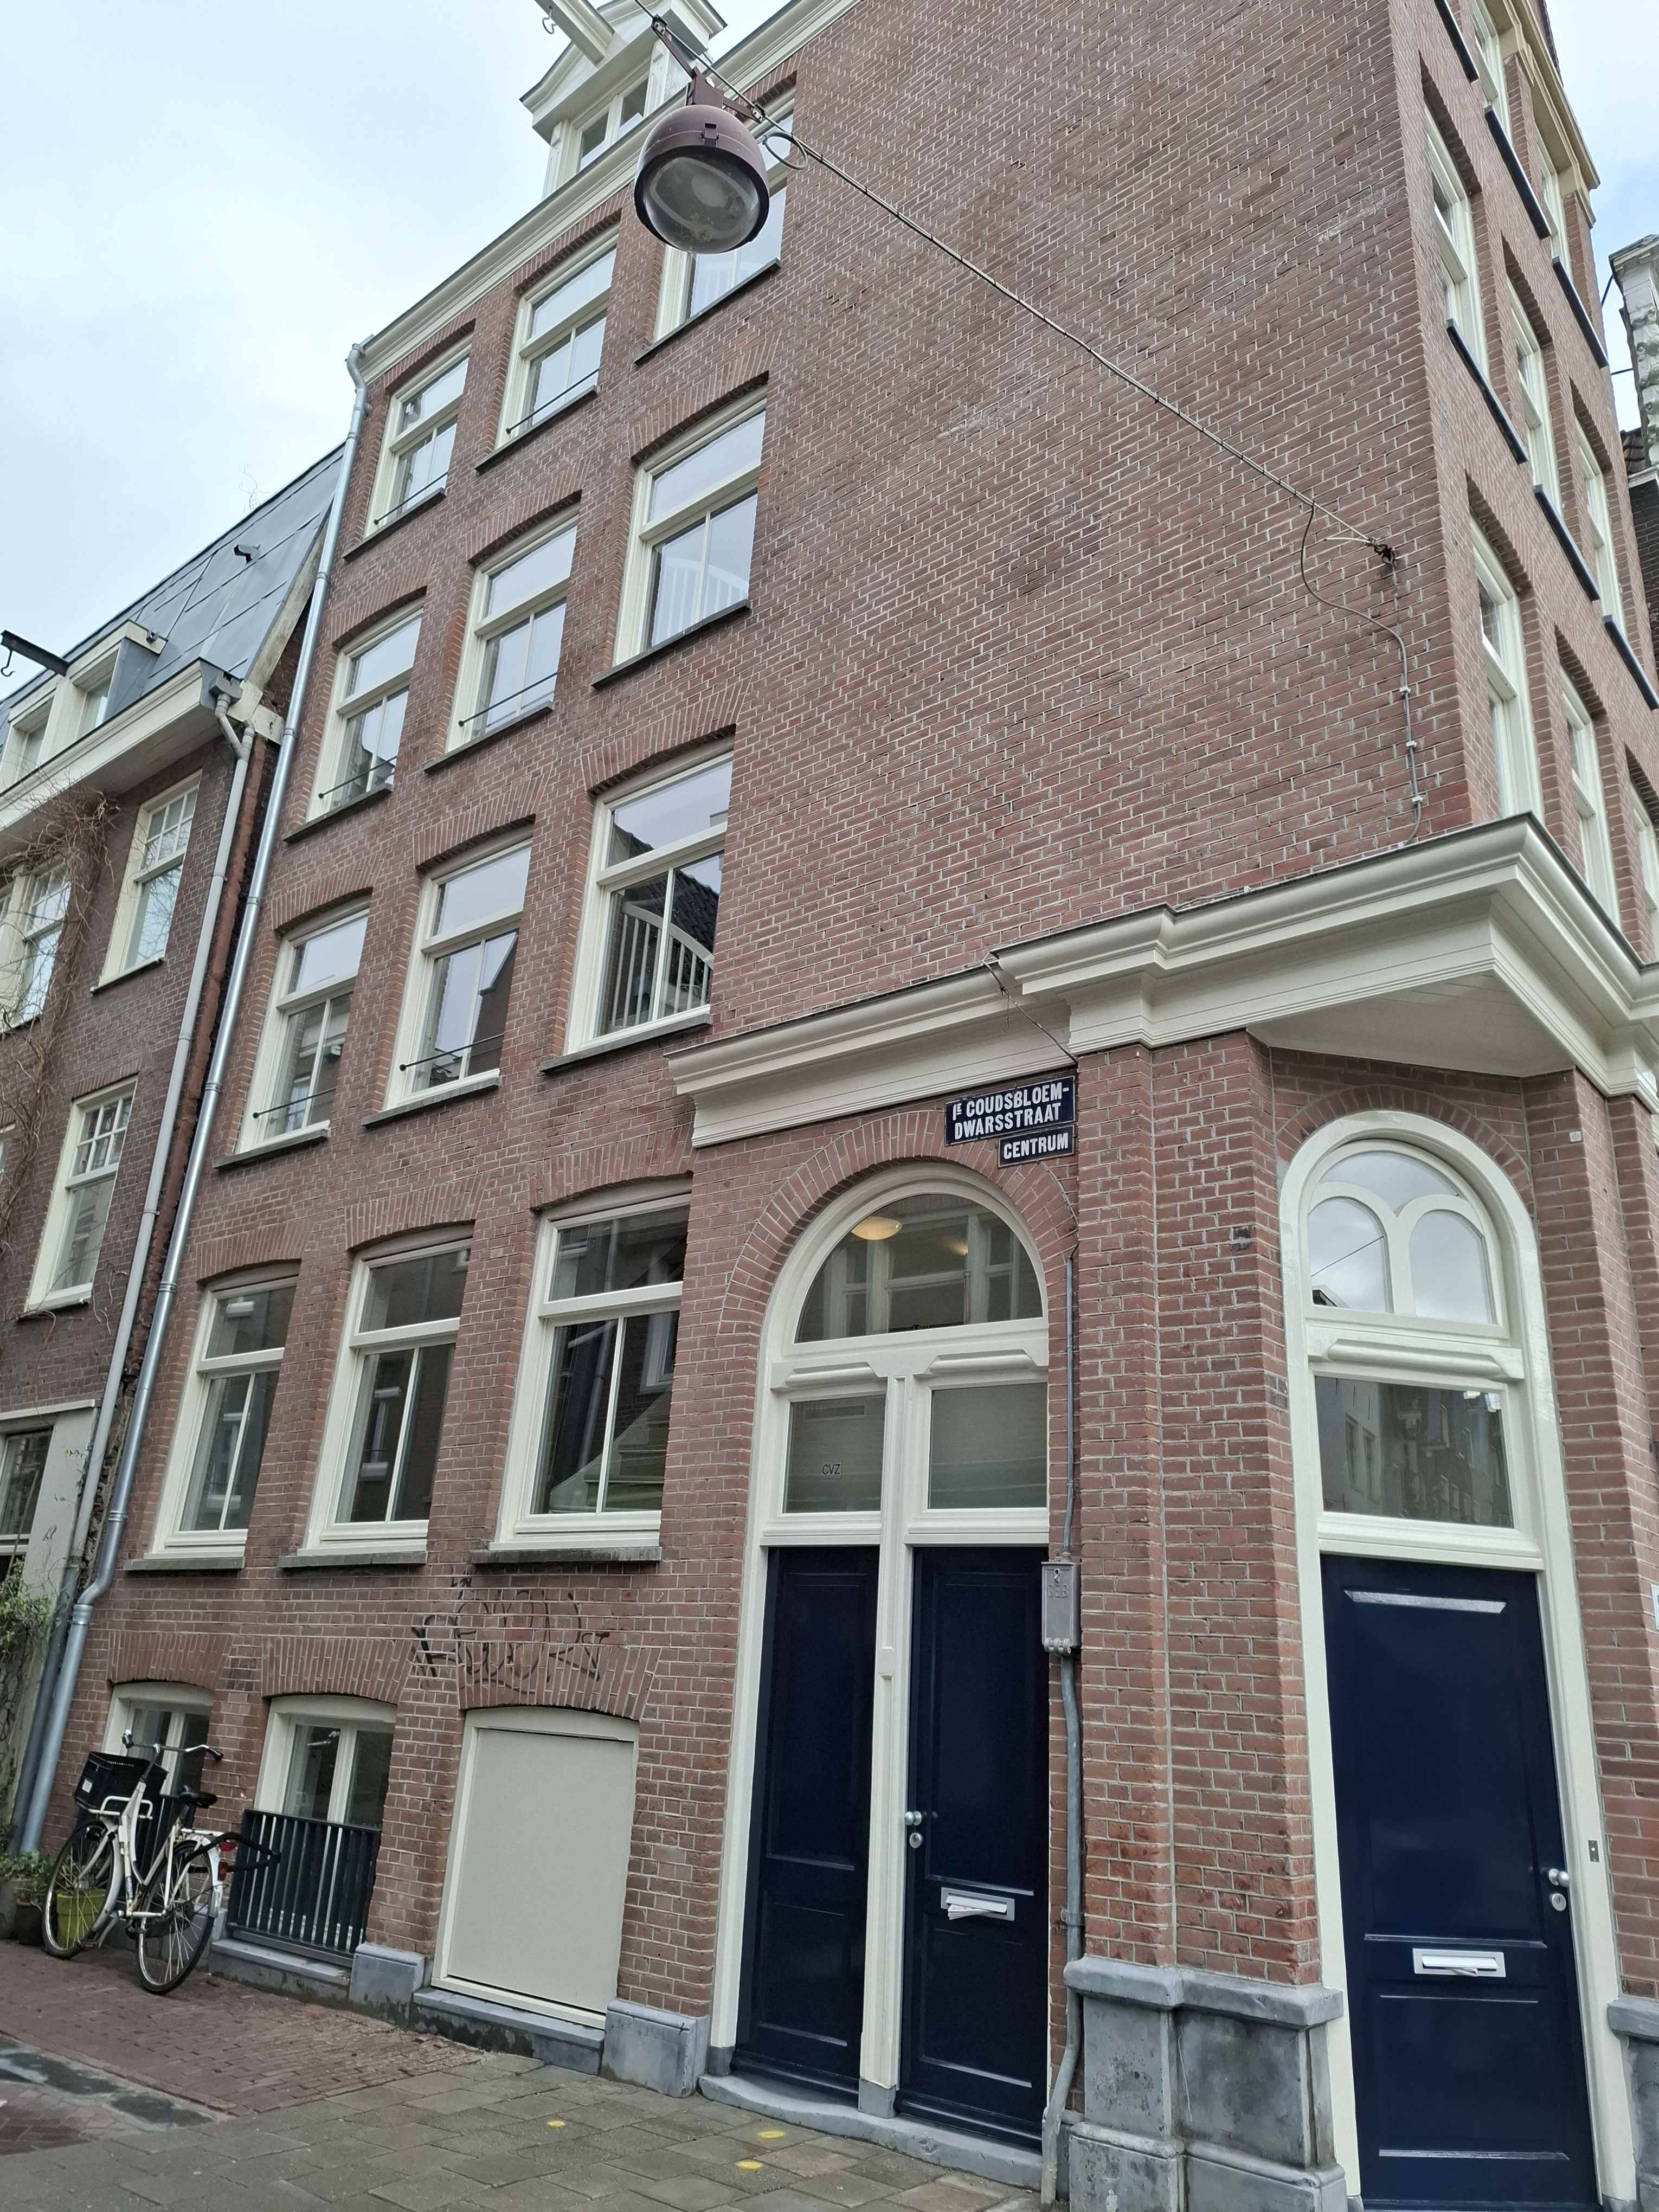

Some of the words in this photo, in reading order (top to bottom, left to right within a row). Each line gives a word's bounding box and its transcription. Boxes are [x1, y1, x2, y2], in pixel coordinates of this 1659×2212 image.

[955, 1102, 1062, 1140] DWARSSTRAAT
[1004, 1132, 1069, 1160] CENTRUM
[822, 1464, 841, 1475] CVZ
